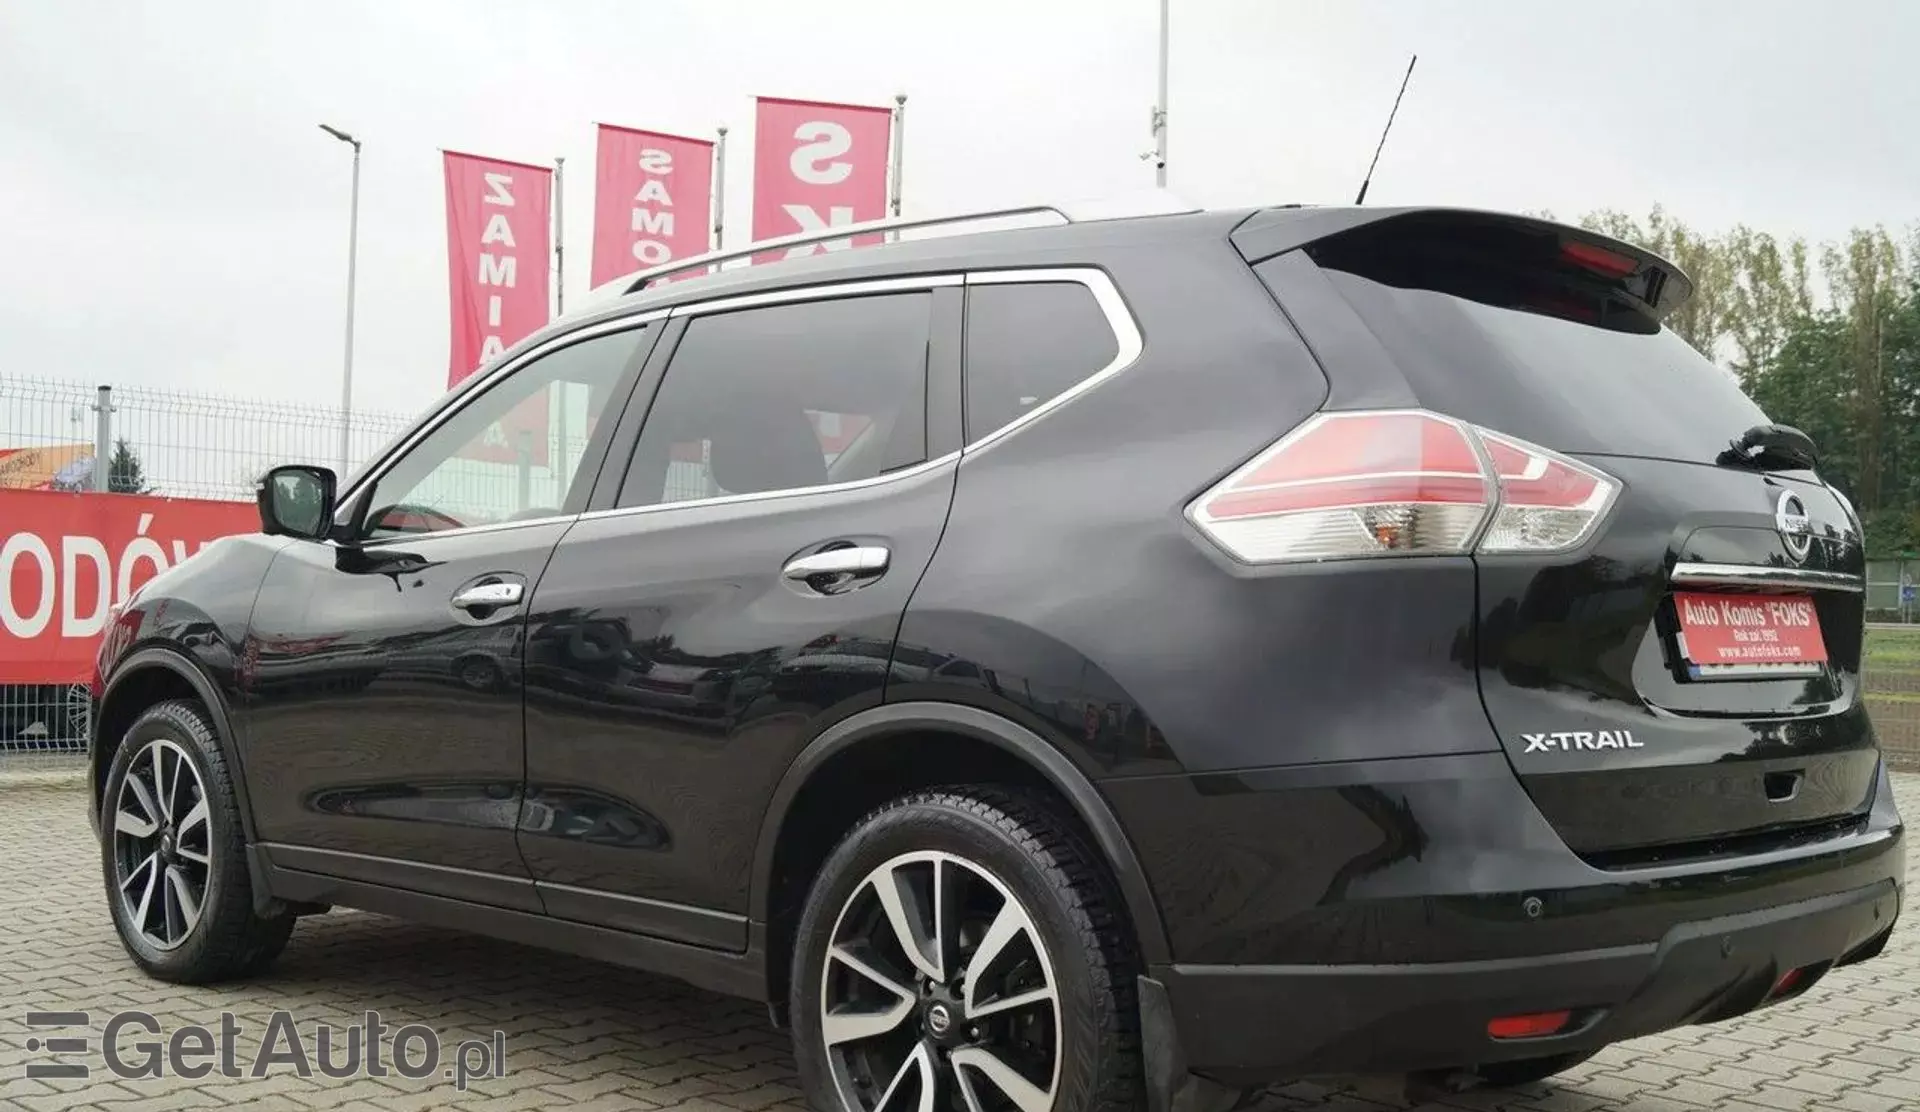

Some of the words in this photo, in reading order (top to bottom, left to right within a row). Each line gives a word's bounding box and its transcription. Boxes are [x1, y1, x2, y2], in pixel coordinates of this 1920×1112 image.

[0, 512, 212, 639] ODÓ
[1684, 599, 1719, 626] Auto
[1720, 600, 1766, 627] Komis
[1521, 730, 1645, 753] X-TRAIL
